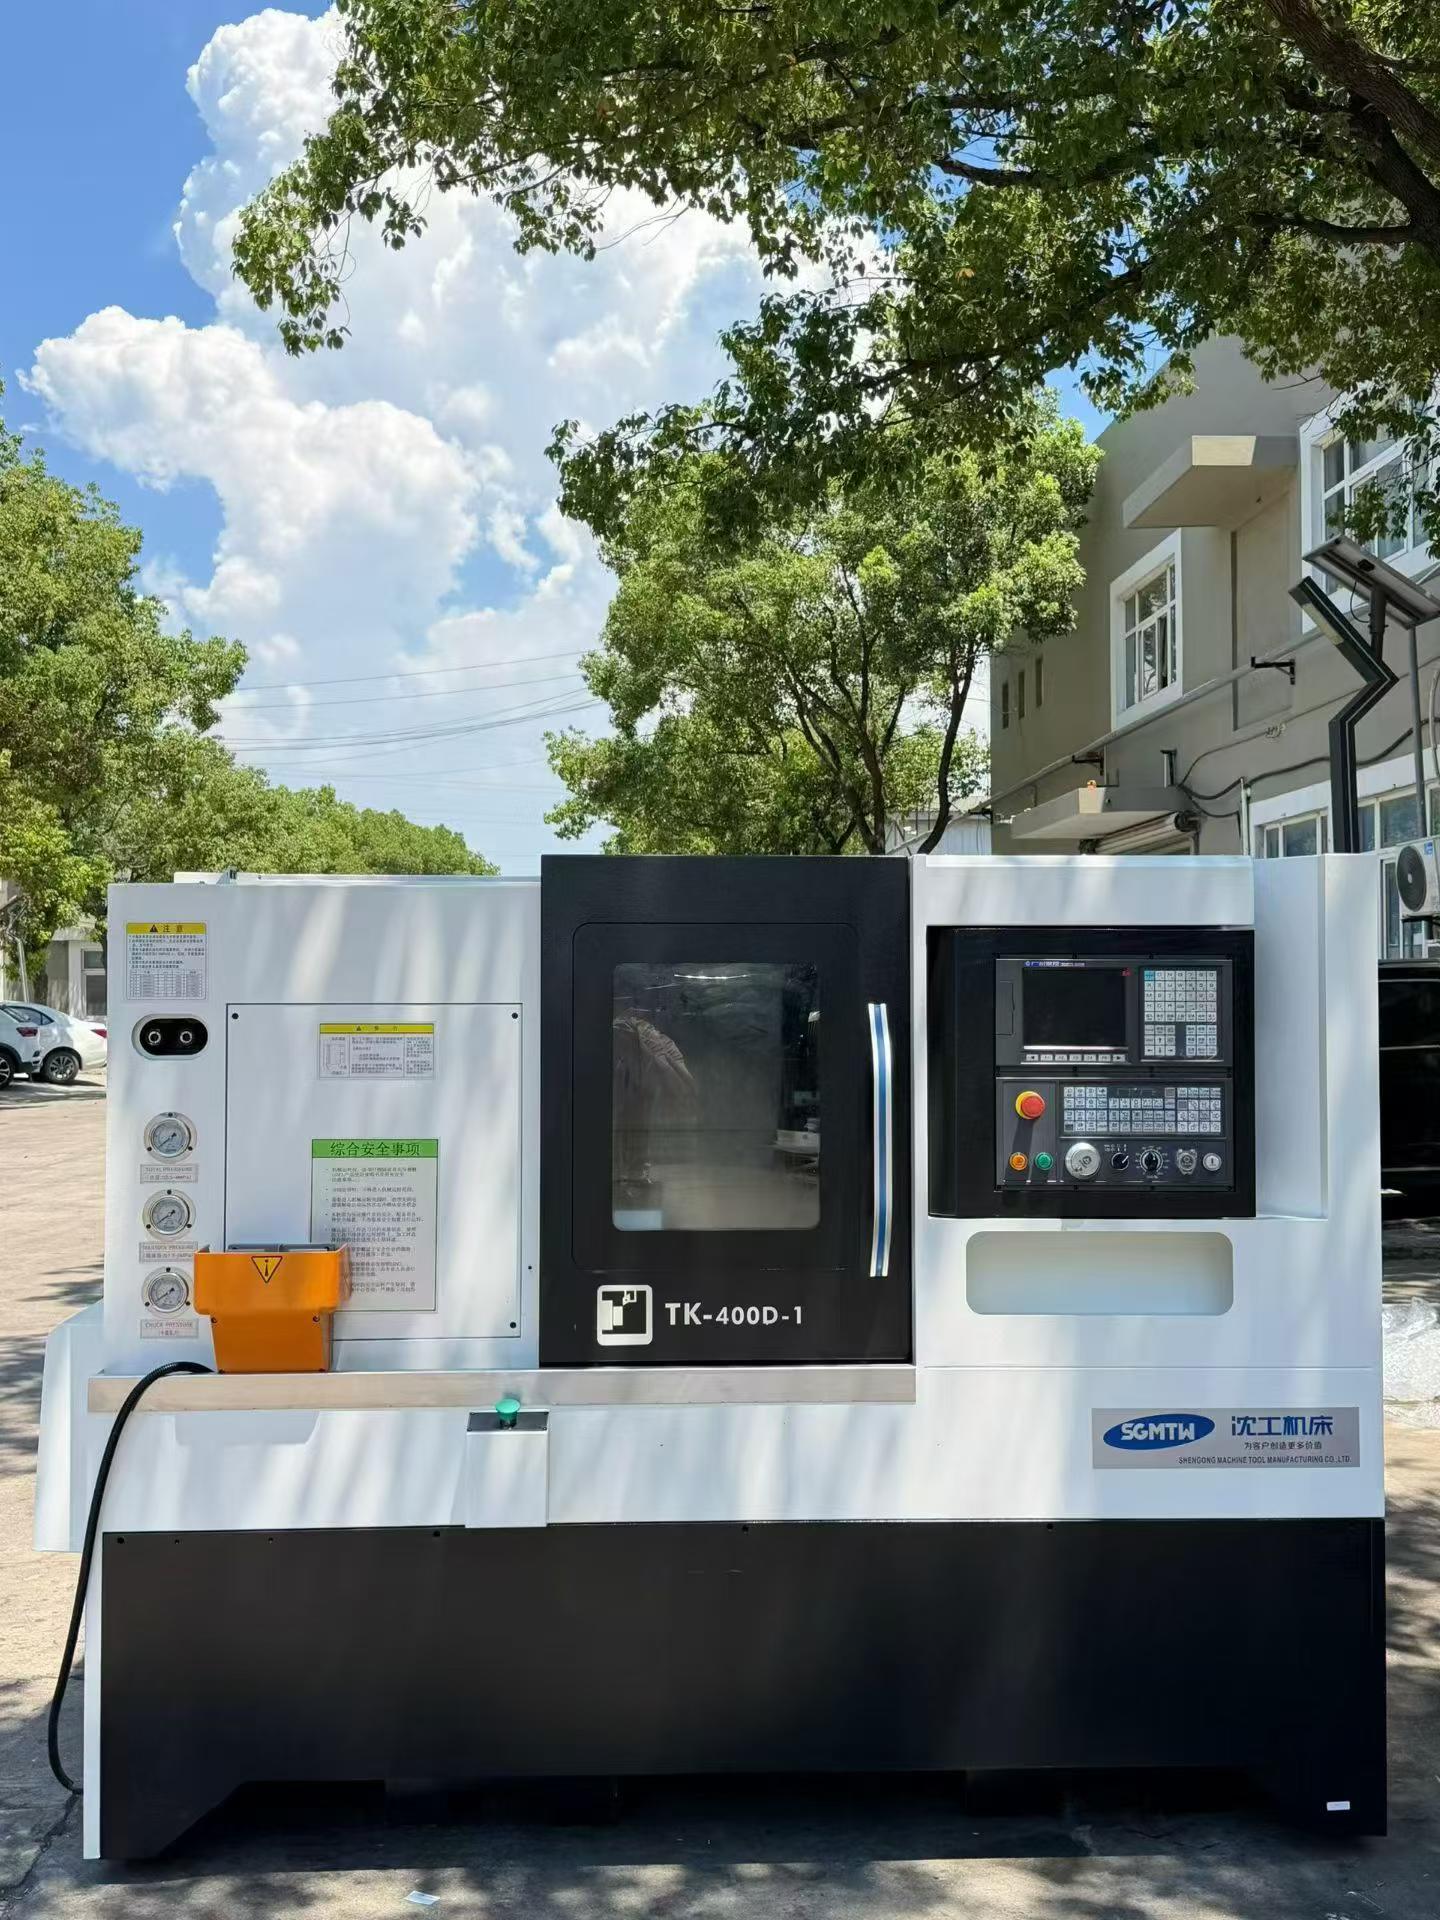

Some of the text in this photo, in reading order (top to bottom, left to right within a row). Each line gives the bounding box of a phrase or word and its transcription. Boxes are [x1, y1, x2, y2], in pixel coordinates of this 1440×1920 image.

[330, 1142, 420, 1157] 综合安全事项
[665, 1302, 802, 1326] TK-400D-1
[1121, 1422, 1195, 1441] SGMTW
[1231, 1415, 1333, 1436] 沈工机床
[1244, 1441, 1322, 1450] 为客户创造更多价值
[1217, 1456, 1247, 1464] MACHINE
